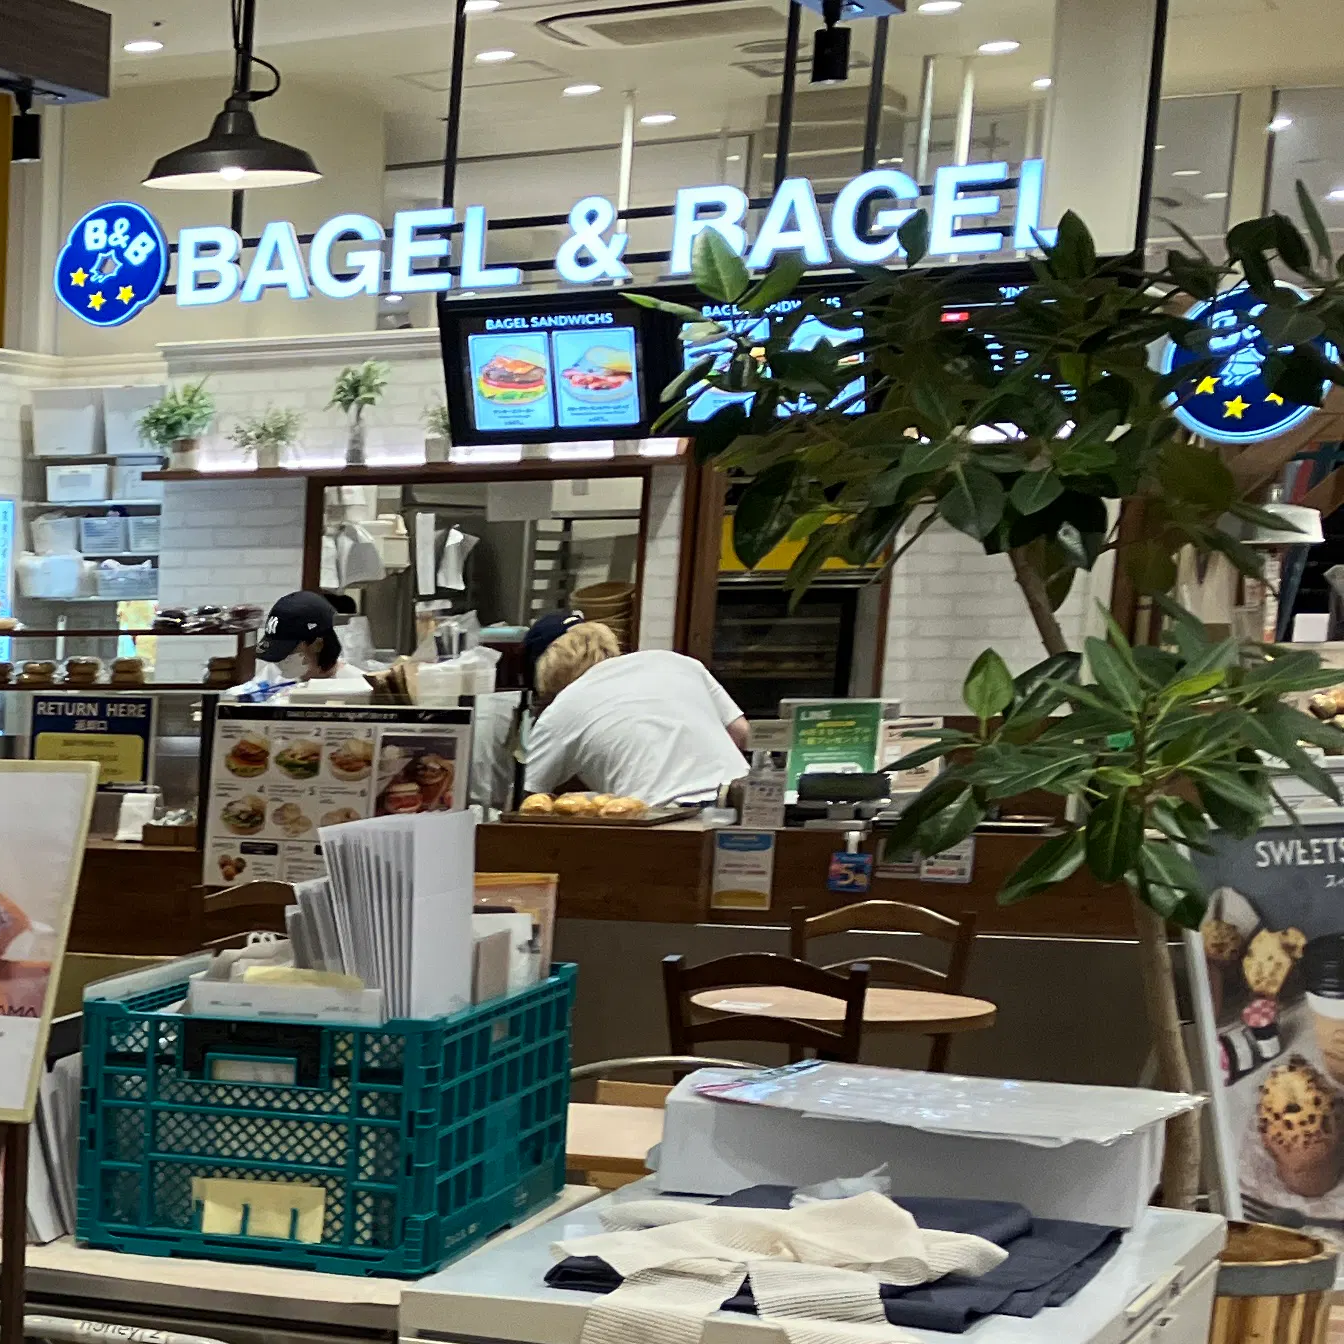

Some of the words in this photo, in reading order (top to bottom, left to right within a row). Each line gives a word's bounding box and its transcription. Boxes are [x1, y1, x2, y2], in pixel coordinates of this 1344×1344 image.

[83, 216, 157, 267] B&B
[175, 205, 522, 306] BAGEL
[555, 196, 631, 284] &
[670, 158, 1060, 275] BAGEL
[485, 317, 529, 330] BAGEL
[530, 312, 614, 328] SANDWICHS
[36, 701, 99, 717] RETURN
[106, 703, 148, 718] HERE
